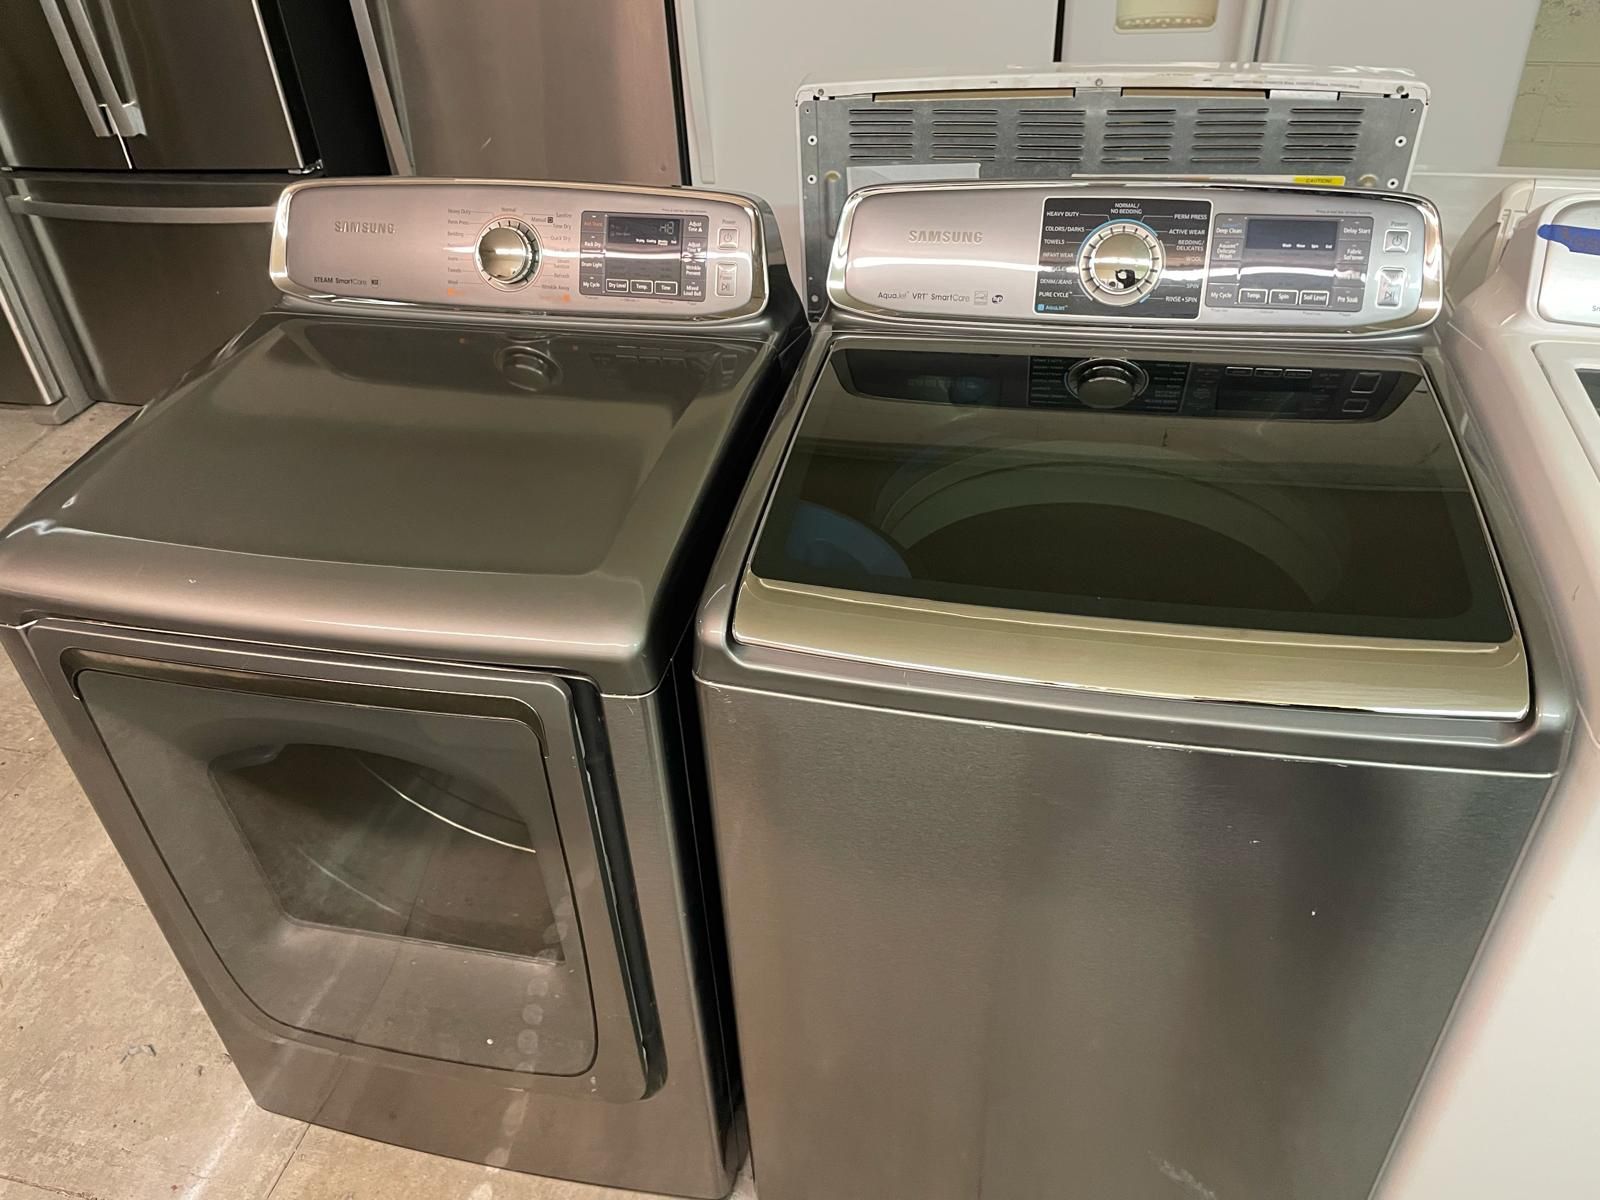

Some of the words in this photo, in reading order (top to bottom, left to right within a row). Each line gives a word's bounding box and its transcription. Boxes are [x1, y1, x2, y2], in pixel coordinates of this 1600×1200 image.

[335, 221, 395, 234] SAMSUNG
[908, 230, 983, 244] SAMSUNG
[931, 293, 970, 302] SmartCare
